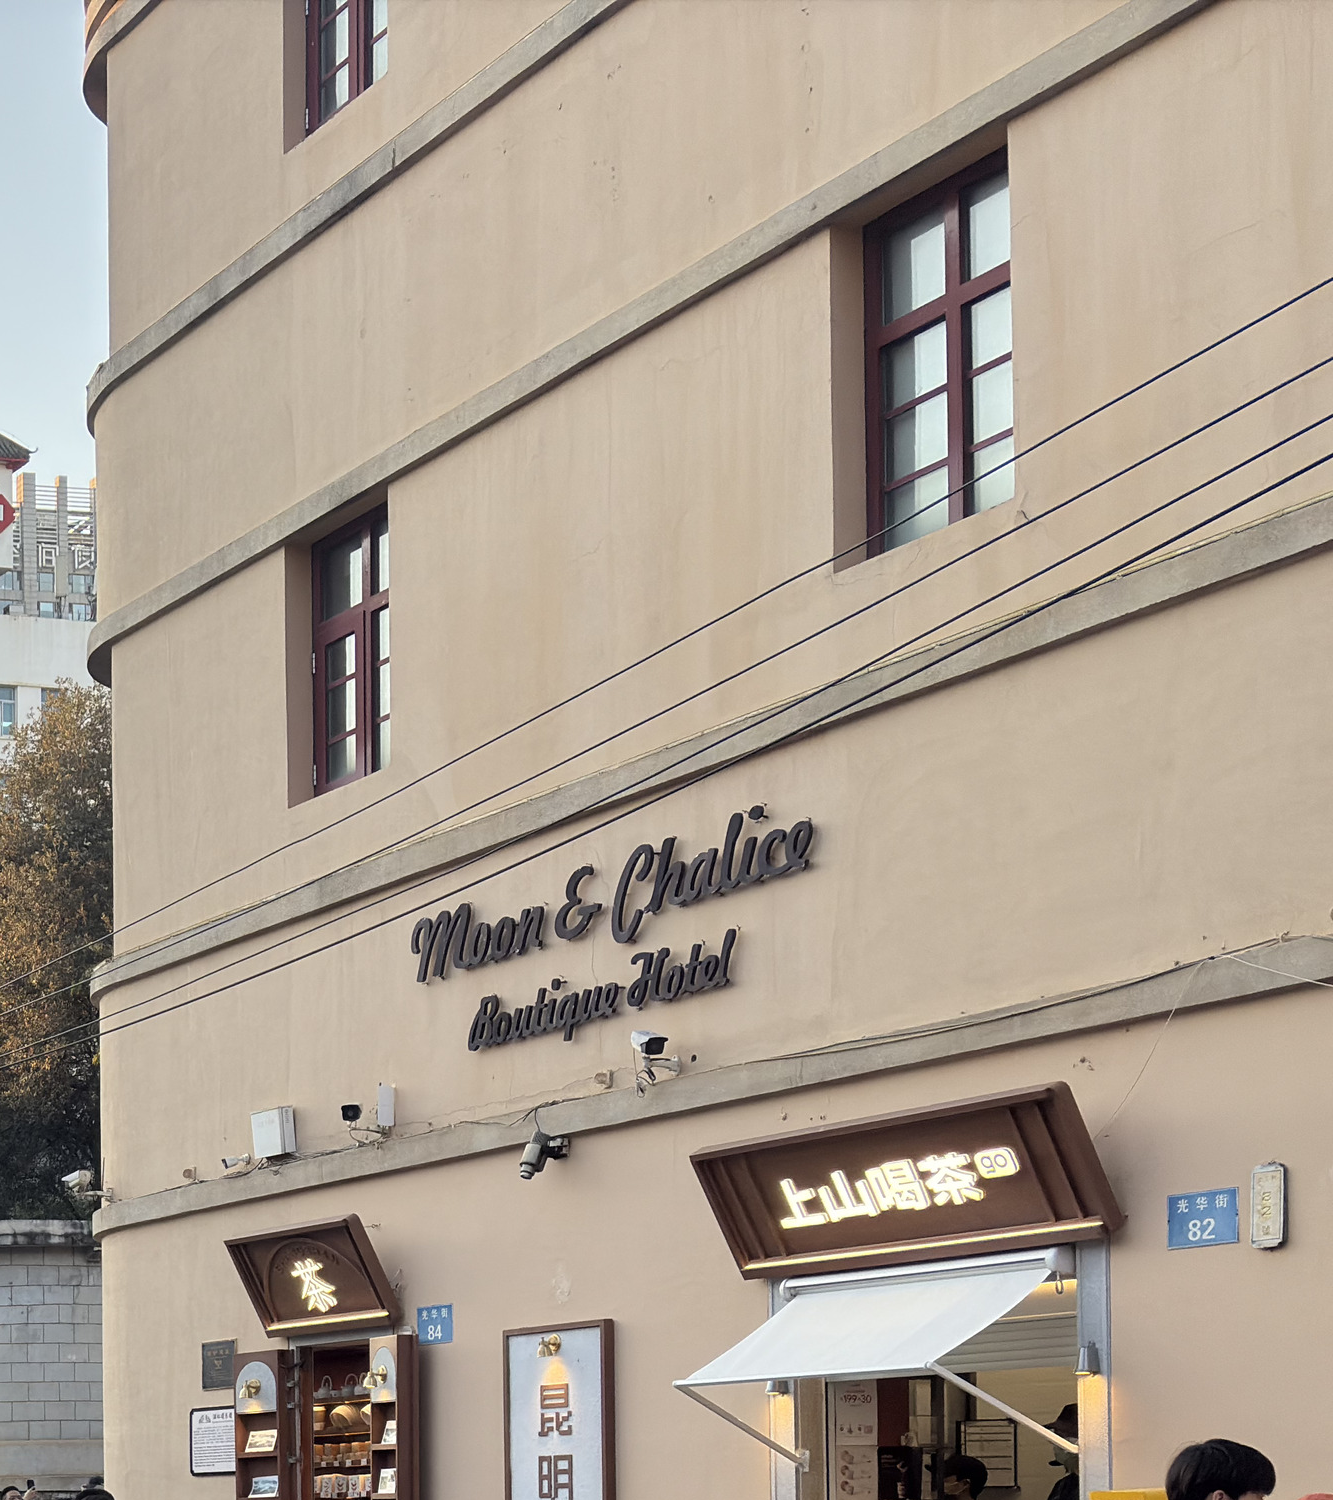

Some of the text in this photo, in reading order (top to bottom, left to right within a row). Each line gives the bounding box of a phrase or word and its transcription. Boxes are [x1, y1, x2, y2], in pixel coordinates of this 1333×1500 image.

[411, 803, 815, 983] Moon & Chalice
[468, 927, 736, 1052] Boutique Hotel
[780, 1151, 985, 1229] 上山喝茶
[1177, 1194, 1228, 1213] 光华街
[1188, 1218, 1215, 1241] 82
[291, 1258, 338, 1313] 茶
[422, 1308, 448, 1320] 光华街
[427, 1324, 442, 1340] 84
